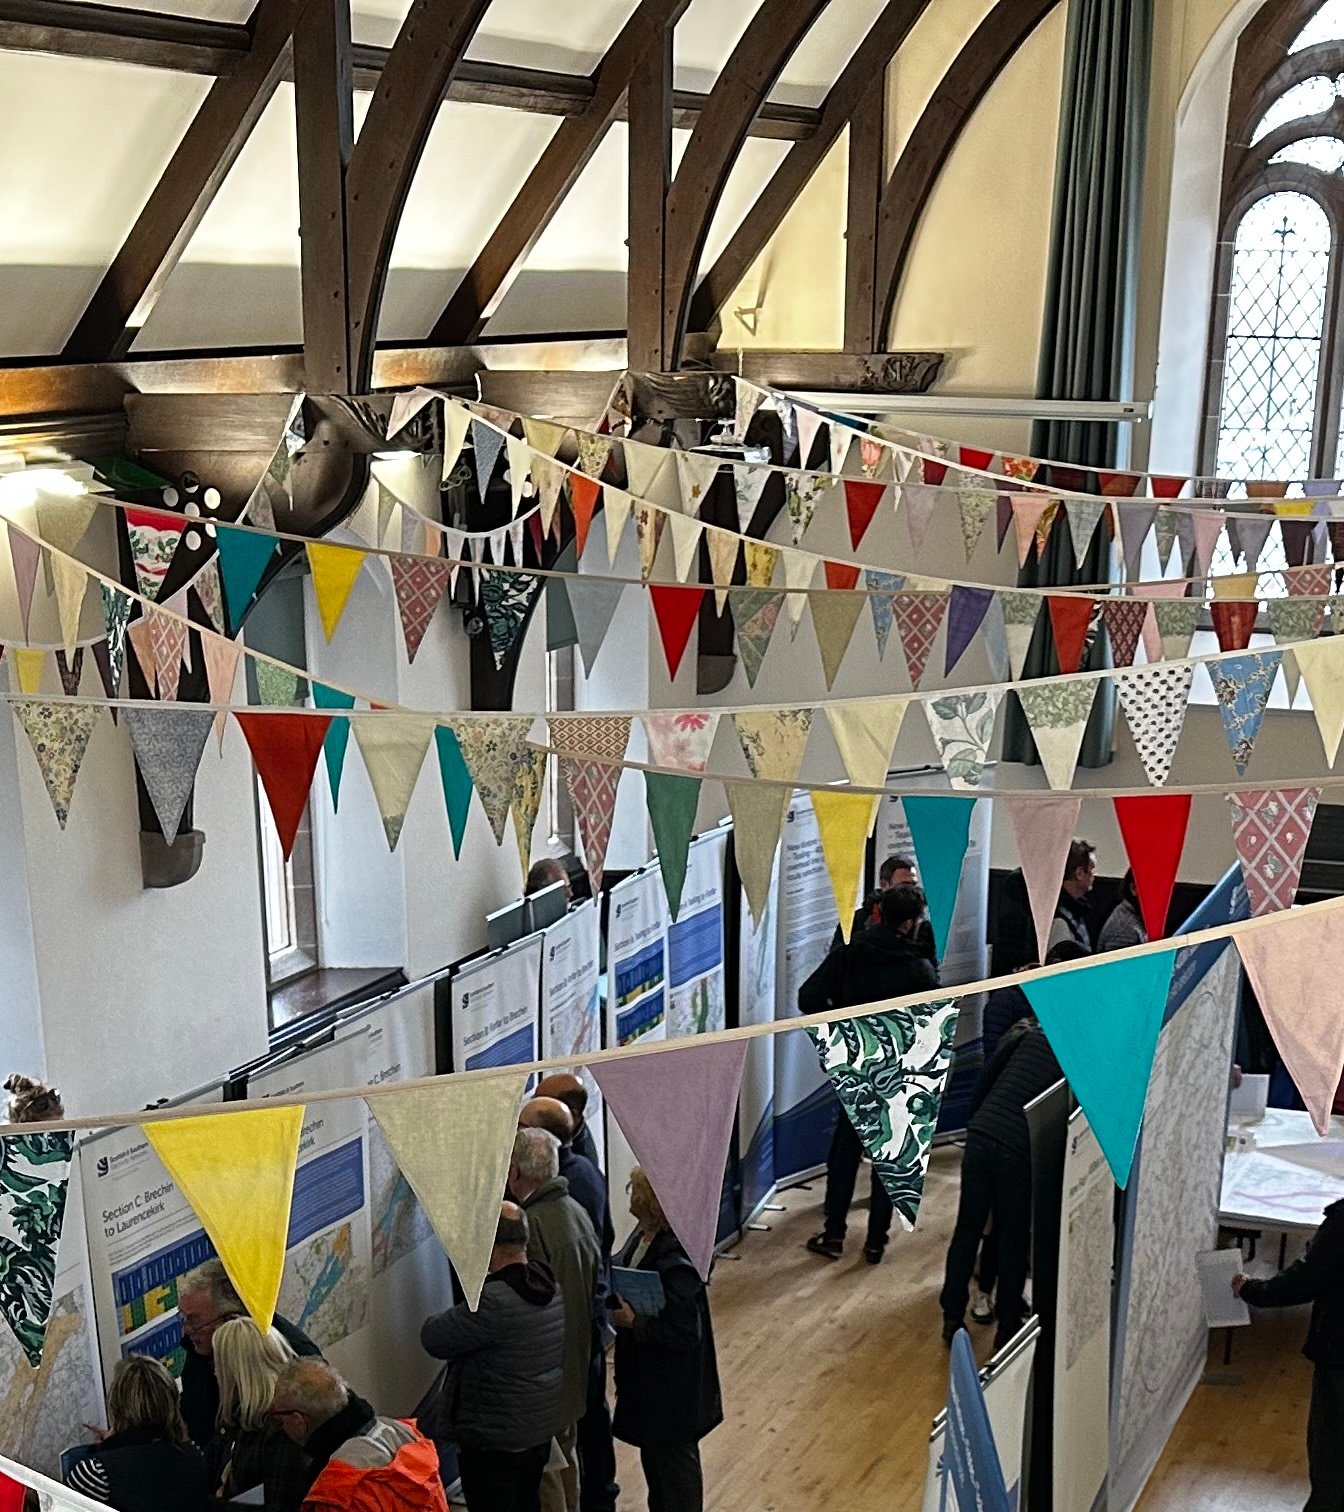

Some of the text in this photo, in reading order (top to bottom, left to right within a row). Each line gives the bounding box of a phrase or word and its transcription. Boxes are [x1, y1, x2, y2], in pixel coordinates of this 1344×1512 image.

[102, 1201, 135, 1223] Section
[144, 1182, 174, 1203] Brechin
[104, 1200, 166, 1238] to Laurencekirk
